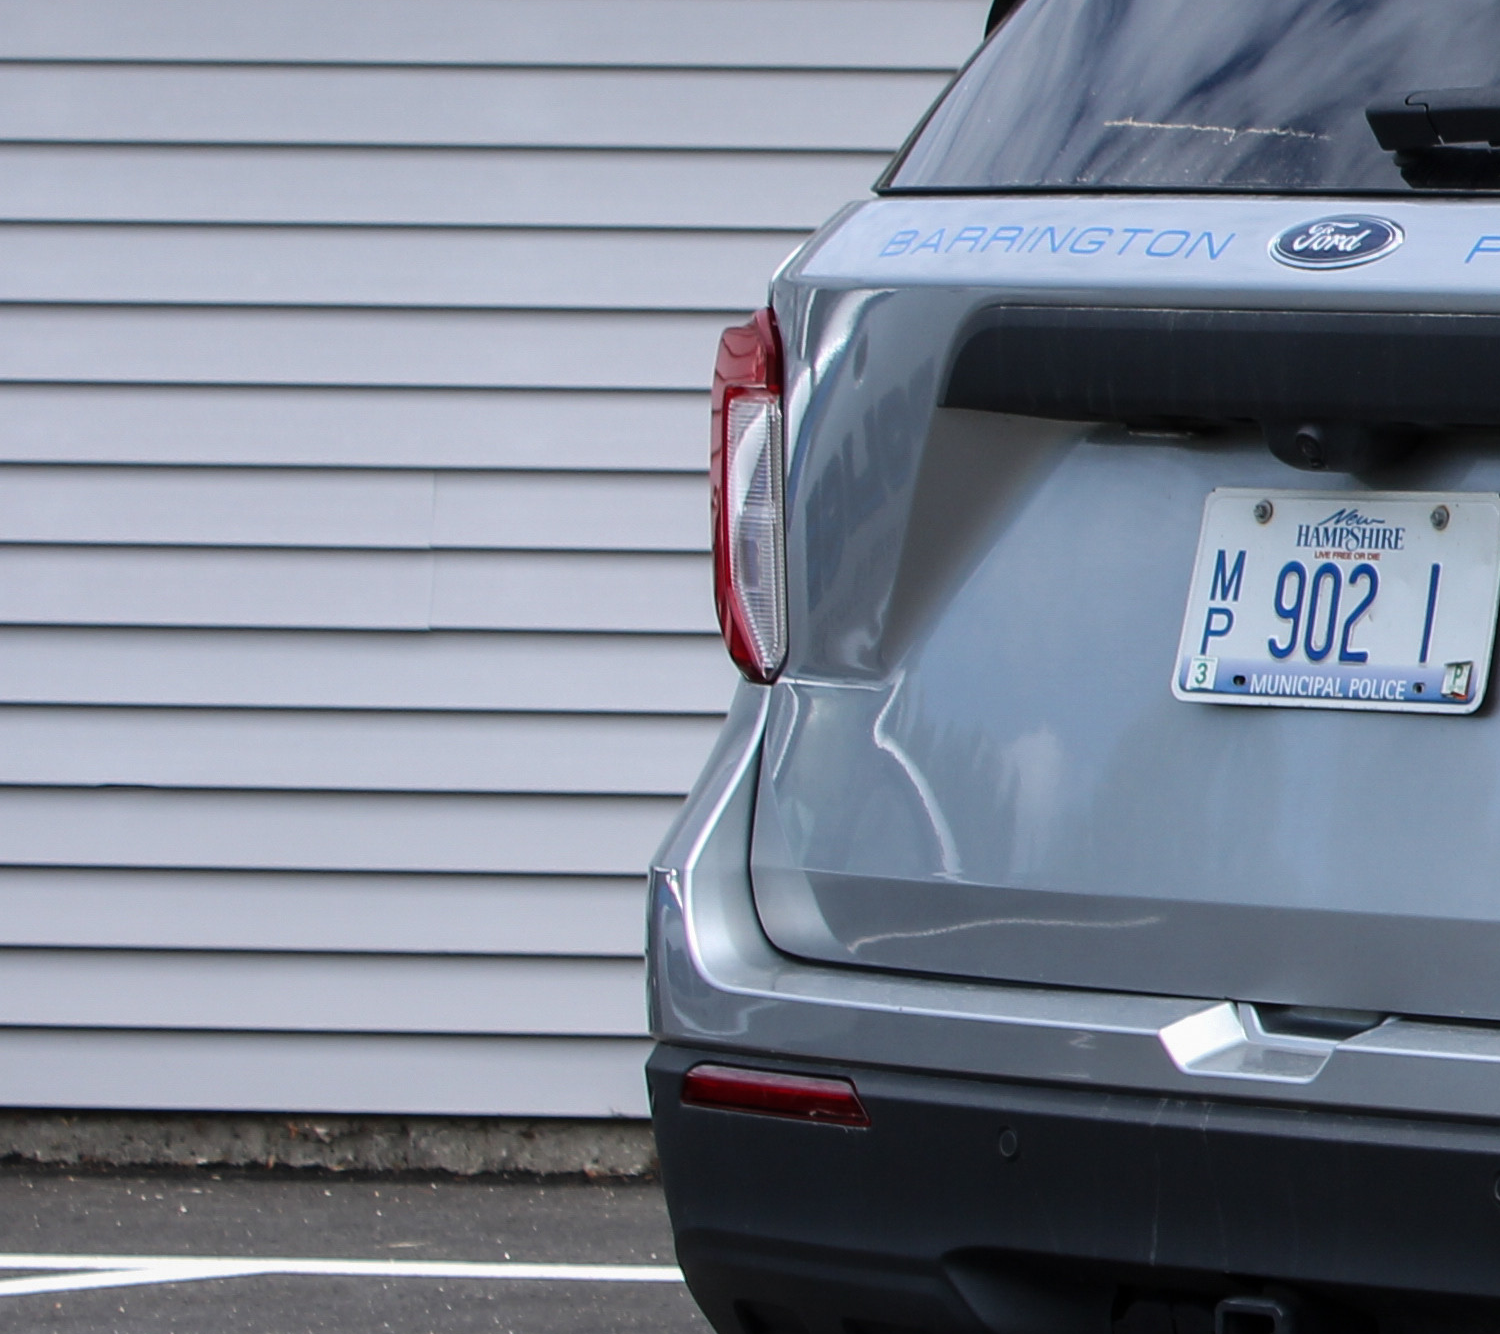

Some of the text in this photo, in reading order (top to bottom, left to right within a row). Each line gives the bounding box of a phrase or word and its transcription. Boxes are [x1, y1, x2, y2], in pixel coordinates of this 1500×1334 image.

[878, 226, 1236, 261] BARRINGTON
[1292, 221, 1372, 252] Ford
[1318, 508, 1385, 527] New
[1296, 524, 1406, 552] HAMPSHIRE
[1314, 551, 1381, 562] LIVE FREE OR DIE
[1267, 560, 1380, 664] 902
[1194, 662, 1209, 685] 3
[1250, 674, 1407, 700] MUNICIPAL POLICE
